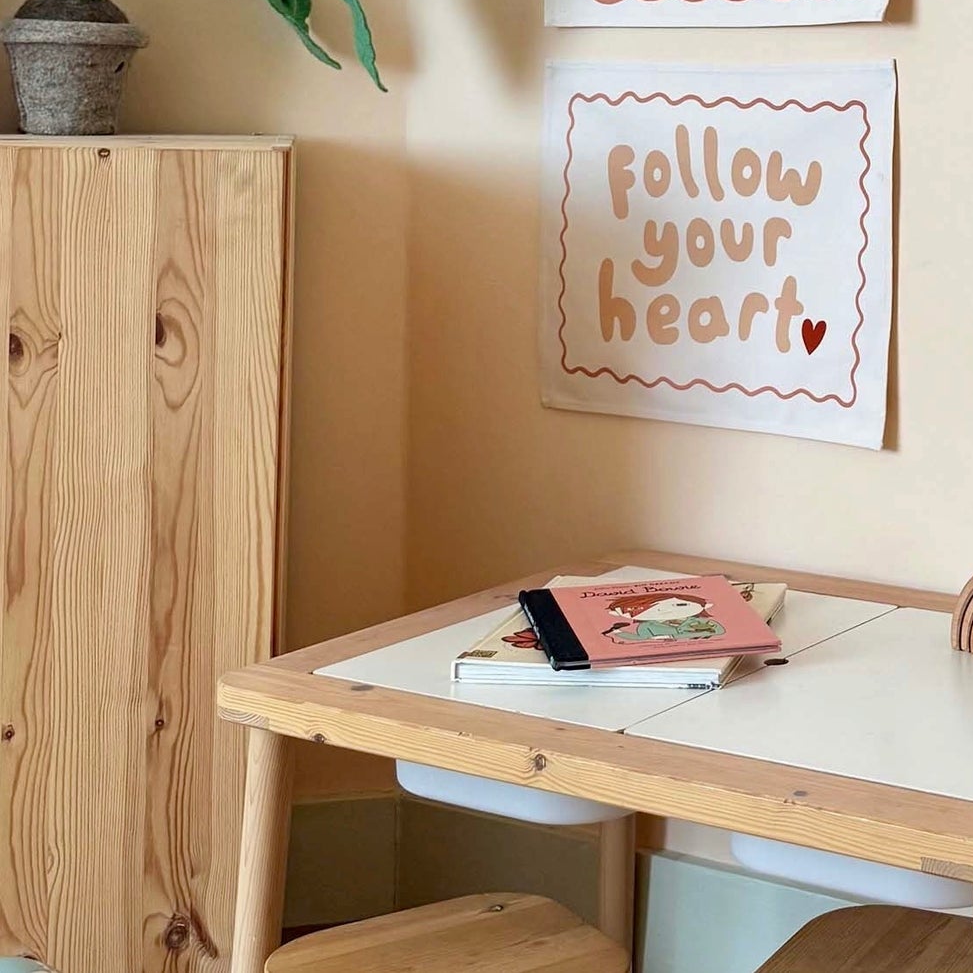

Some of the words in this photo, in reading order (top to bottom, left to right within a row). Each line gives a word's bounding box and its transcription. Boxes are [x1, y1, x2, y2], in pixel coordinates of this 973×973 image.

[607, 123, 823, 220] follow
[630, 217, 793, 287] your
[598, 257, 804, 354] heart
